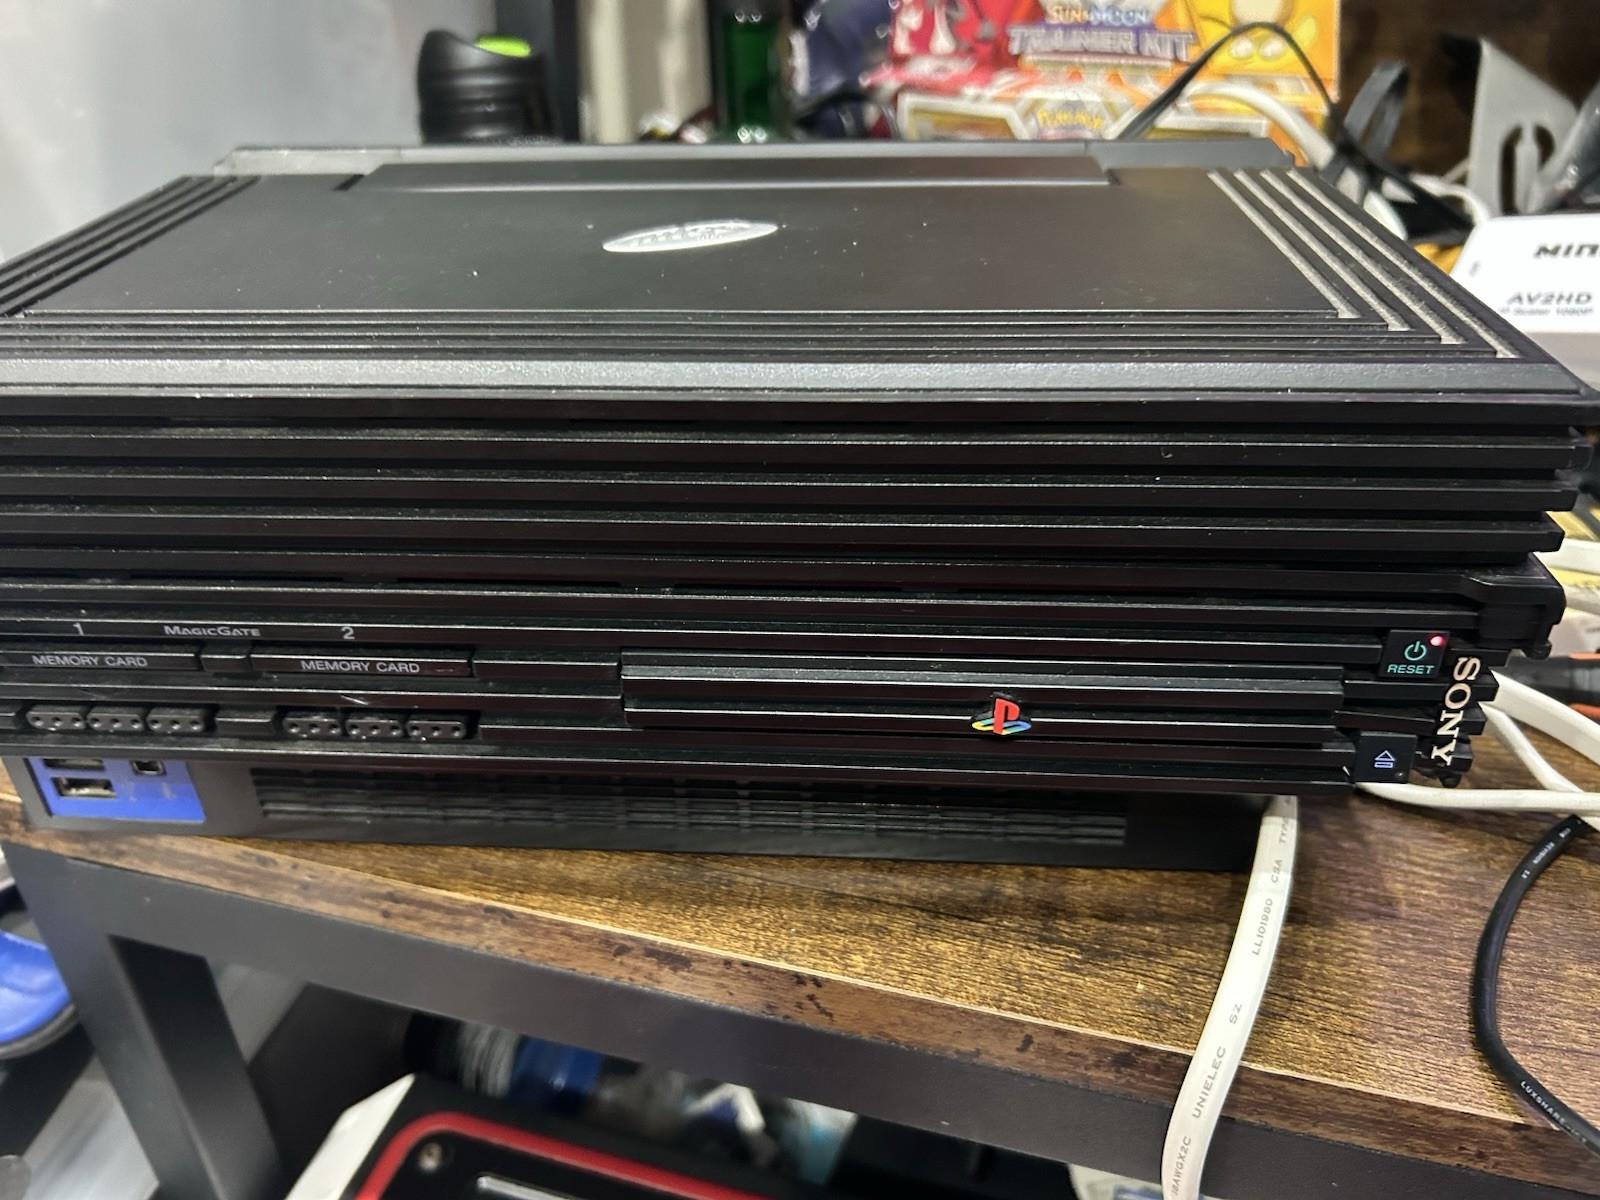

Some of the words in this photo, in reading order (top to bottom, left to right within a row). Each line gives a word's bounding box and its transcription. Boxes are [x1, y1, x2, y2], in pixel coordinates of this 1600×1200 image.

[73, 622, 84, 635] 1
[341, 626, 355, 640] 2
[32, 655, 99, 666] MEMORY
[104, 656, 148, 668] CARD
[301, 660, 370, 672] MEMORY
[376, 662, 421, 673] CARD
[1387, 664, 1434, 674] RESET
[1431, 656, 1481, 766] SONY
[1192, 1046, 1226, 1119] UNIELEC
[1271, 859, 1283, 883] CSA
